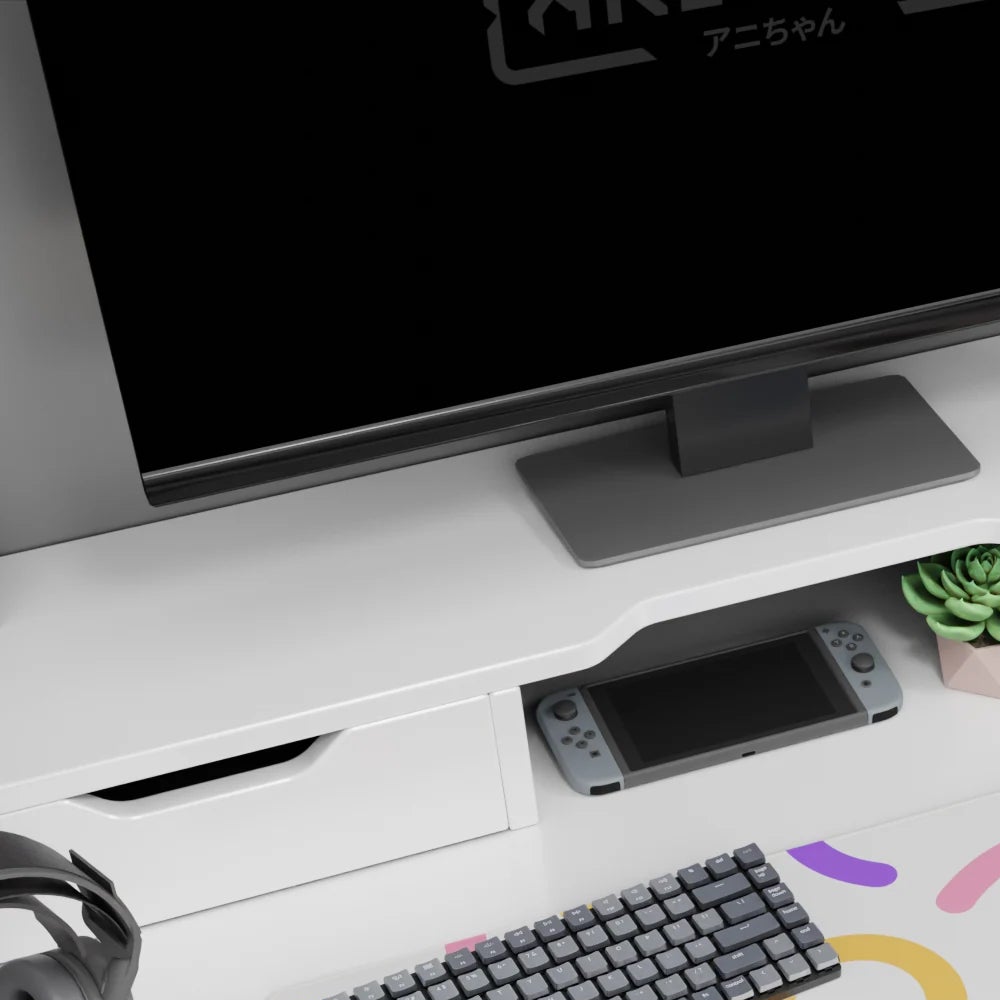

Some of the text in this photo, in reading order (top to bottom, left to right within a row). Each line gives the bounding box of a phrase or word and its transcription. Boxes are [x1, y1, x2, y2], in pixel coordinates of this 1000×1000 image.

[703, 7, 846, 57] アニちゃん
